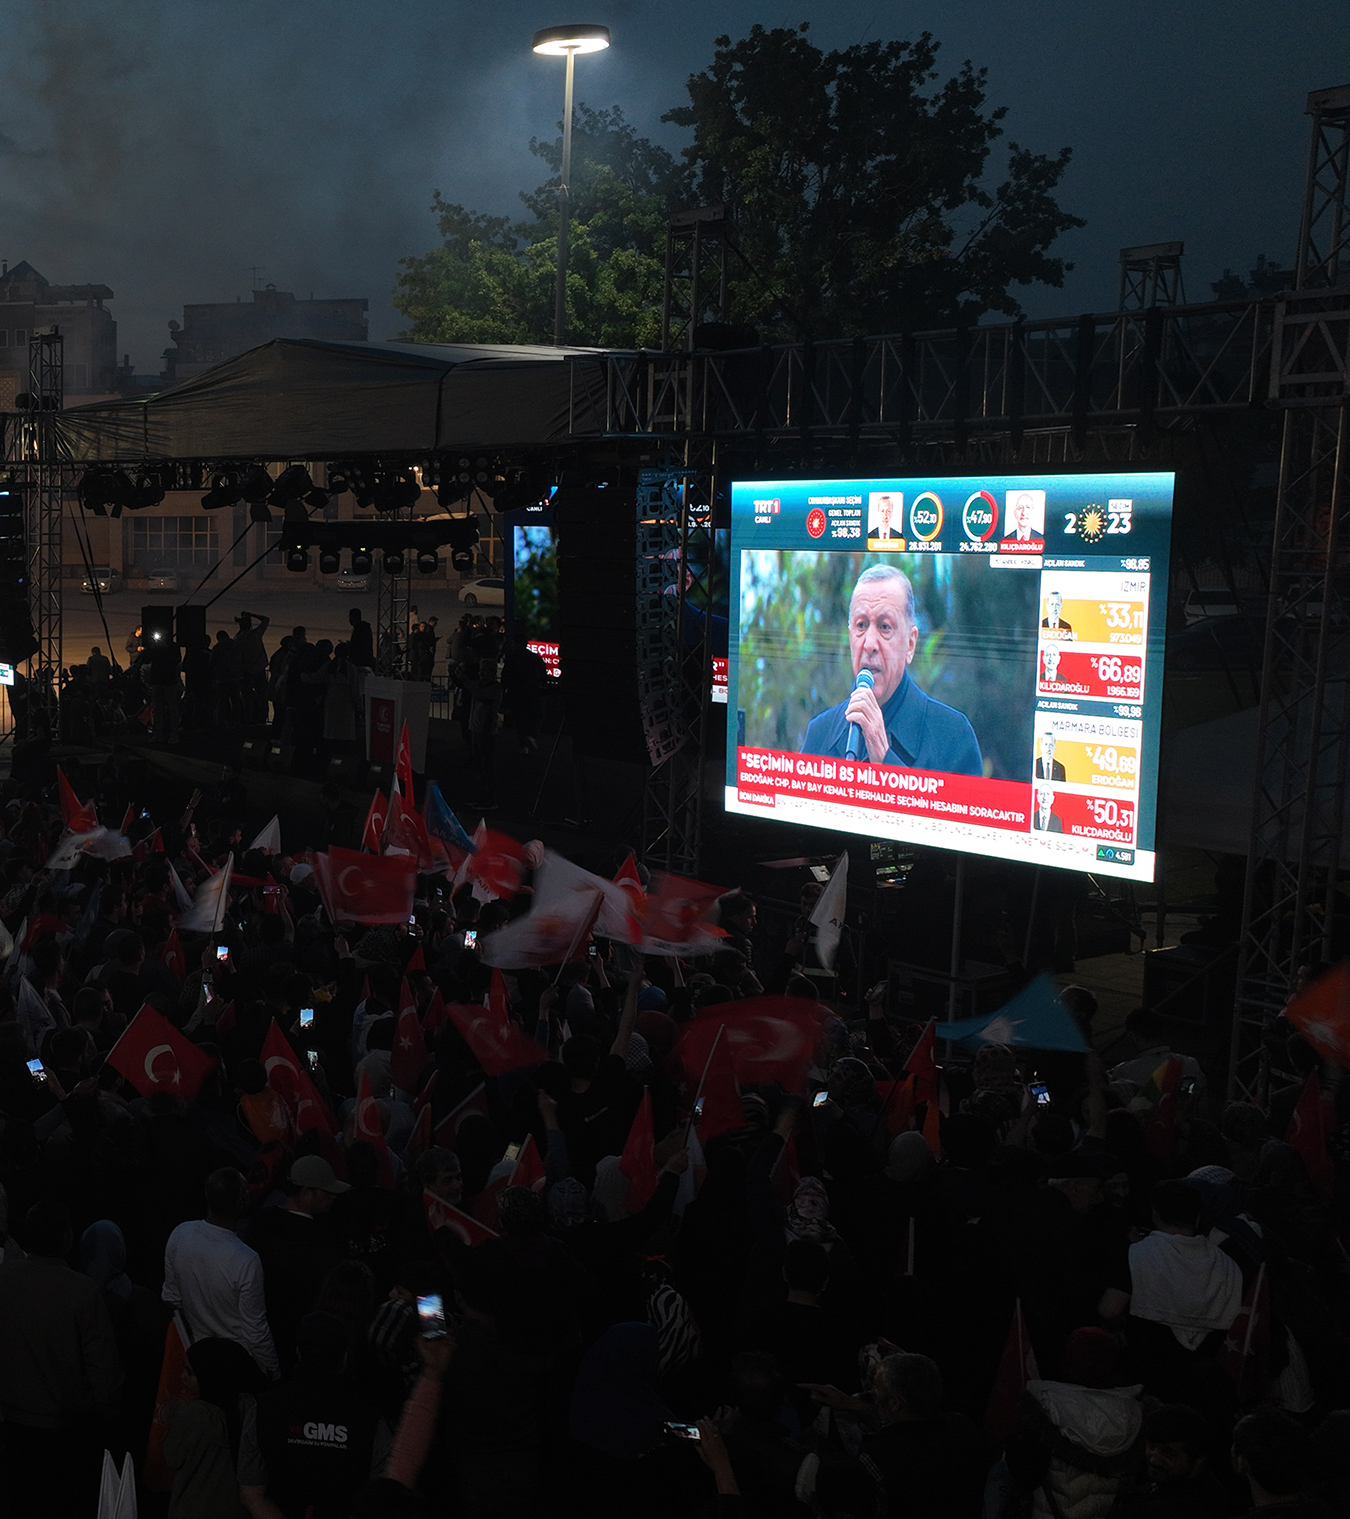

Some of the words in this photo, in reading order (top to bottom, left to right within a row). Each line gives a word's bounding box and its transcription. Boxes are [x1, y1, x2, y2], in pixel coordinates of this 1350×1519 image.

[831, 527, 861, 538] %98,38
[1090, 656, 1141, 683] %66,89
[1039, 682, 1090, 694] KILIÇDAROĞLU
[1113, 705, 1142, 718] %99,98
[1052, 720, 1096, 734] MARMARA
[1085, 746, 1136, 774] %49,69
[741, 752, 793, 773] "SEÇİMİN
[796, 760, 837, 779] GALİBİ
[839, 766, 854, 782] 85
[857, 766, 944, 794] MİLYONDUR"
[1092, 774, 1134, 788] ERDOĞAN
[775, 777, 791, 789] CHP,
[791, 780, 806, 791] BAY
[807, 782, 822, 793] BAY
[823, 784, 854, 797] KEMAL'E
[855, 789, 895, 804] HERHALDE
[897, 794, 929, 810] SEÇİMİN
[930, 801, 968, 815] HESABINI
[969, 806, 1025, 824] SORACAKTIR
[1086, 799, 1133, 827] %50,31
[1072, 825, 1132, 841] KILIÇDAROĞLU
[303, 1421, 349, 1443] GMS
